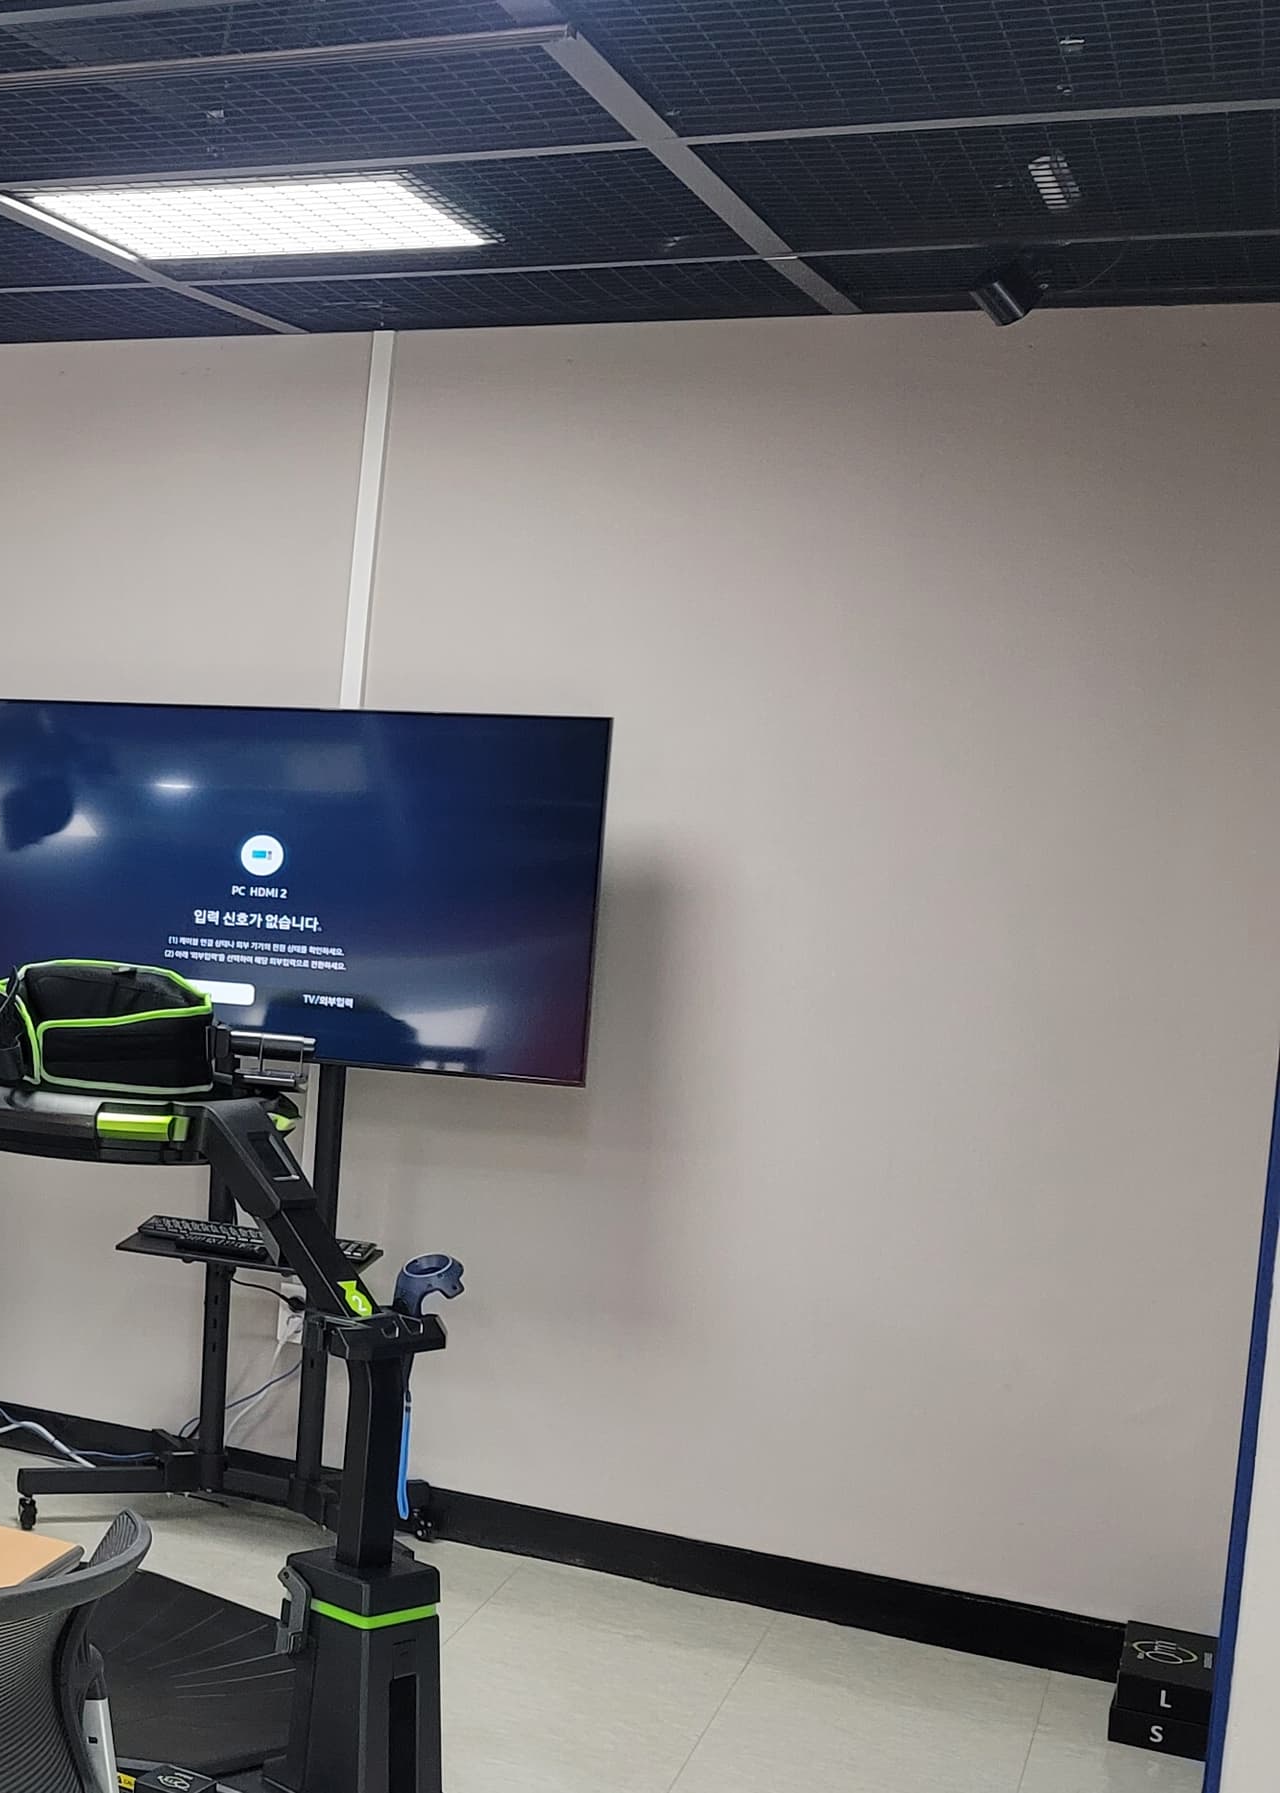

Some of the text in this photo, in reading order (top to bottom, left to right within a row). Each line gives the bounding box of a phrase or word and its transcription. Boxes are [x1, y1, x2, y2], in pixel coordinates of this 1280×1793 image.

[231, 885, 288, 899] PC HDMI 2
[193, 909, 322, 932] 입력 신호가 없습니다.
[352, 1295, 367, 1312] 2
[1159, 1689, 1172, 1709] L
[1149, 1725, 1164, 1743] S
